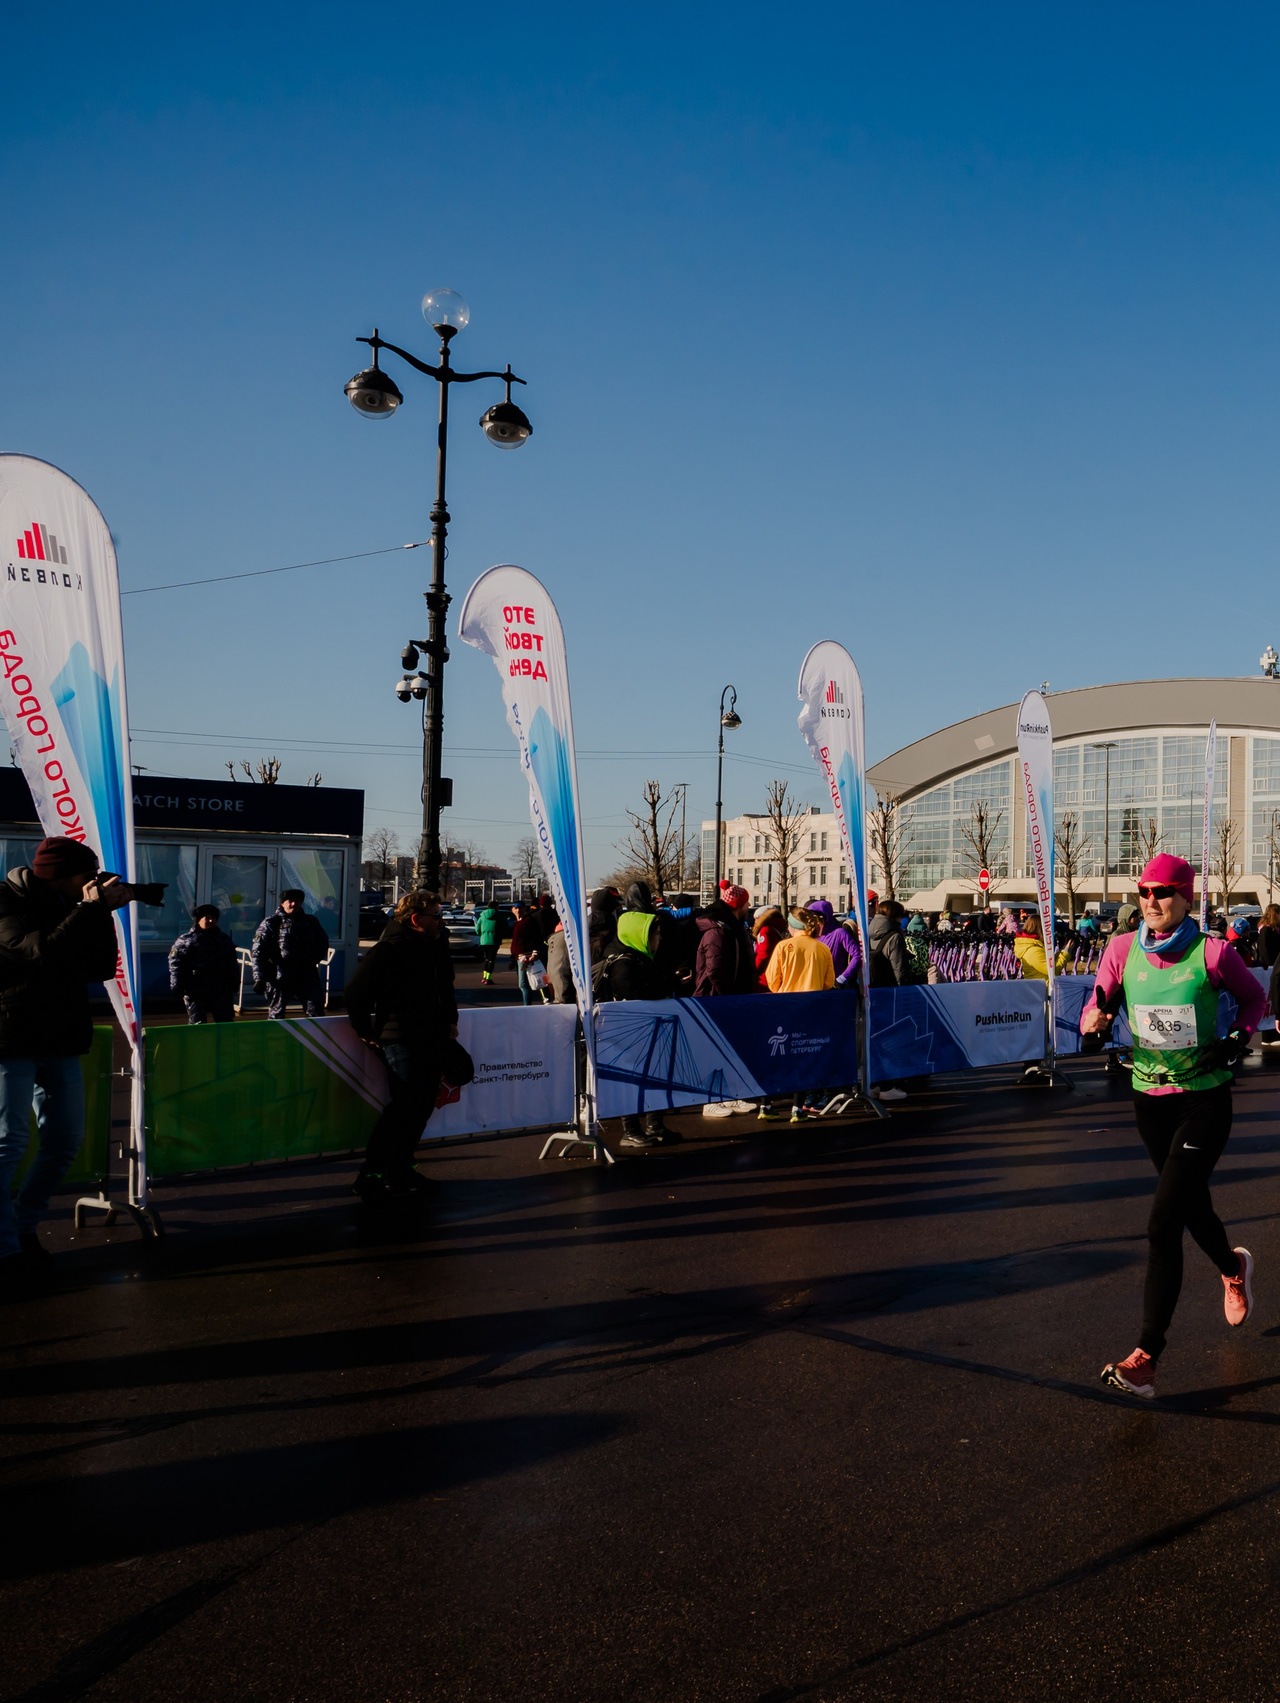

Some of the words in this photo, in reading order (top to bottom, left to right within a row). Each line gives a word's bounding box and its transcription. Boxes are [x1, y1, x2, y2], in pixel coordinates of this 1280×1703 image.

[133, 794, 180, 809] ATCH
[187, 797, 245, 812] STORE
[975, 1010, 1032, 1026] PushkinRun
[1148, 1020, 1182, 1032] 6835
[480, 1060, 543, 1073] Правительство
[472, 1071, 550, 1085] Санкт-Петербурга
